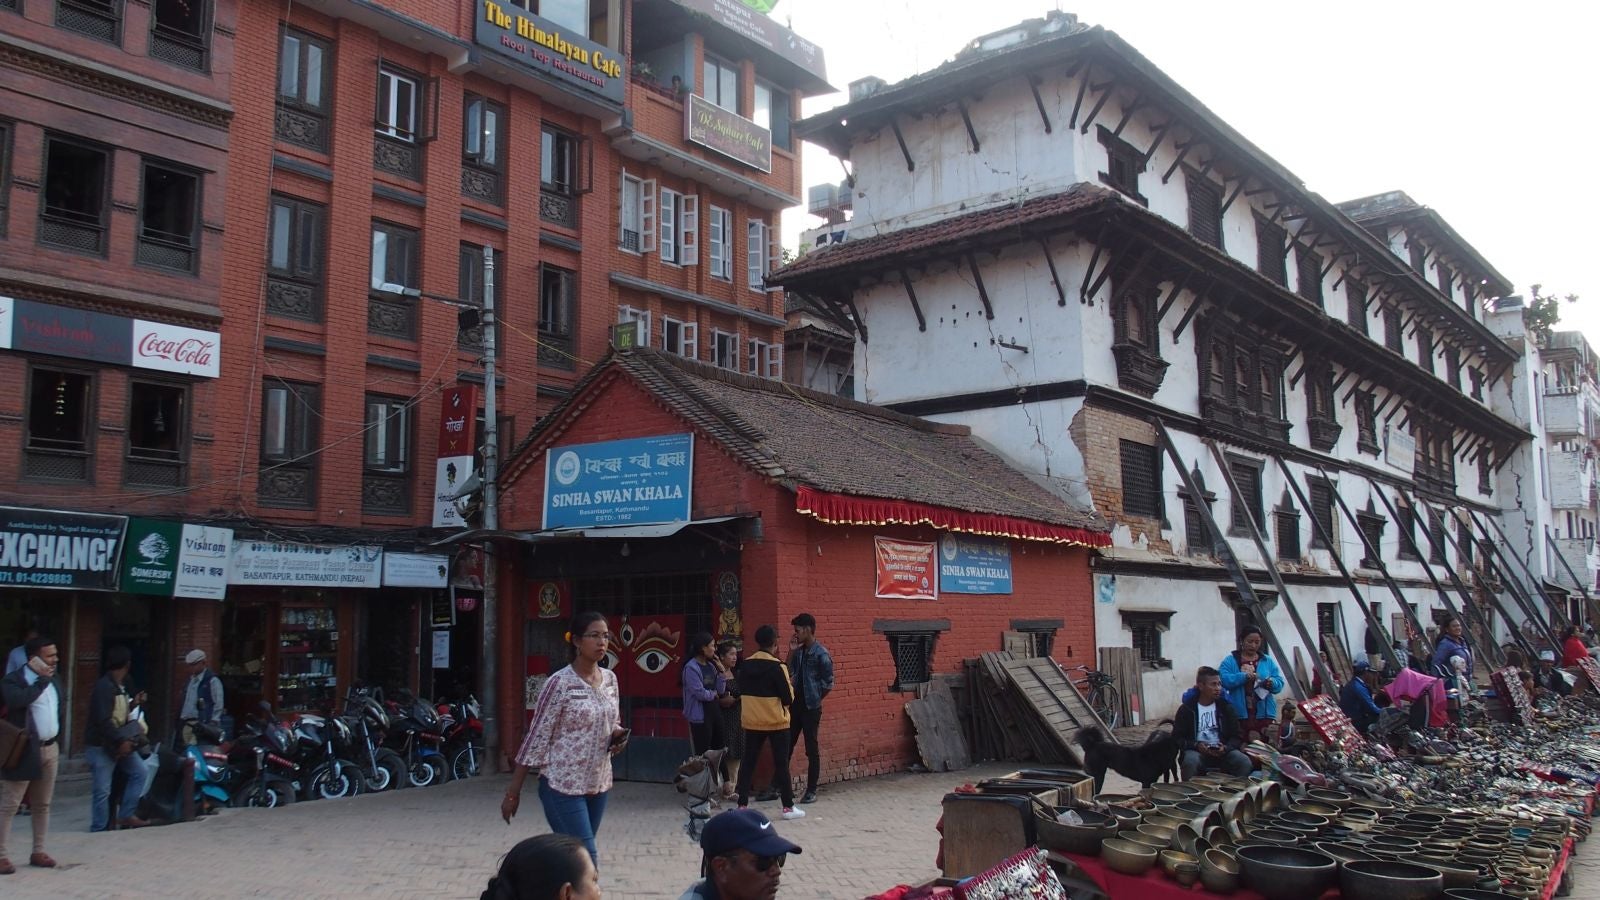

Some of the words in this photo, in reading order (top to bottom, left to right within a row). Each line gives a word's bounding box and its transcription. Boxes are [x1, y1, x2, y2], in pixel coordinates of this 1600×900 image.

[485, 1, 512, 29] The
[516, 15, 589, 63] Himalayan
[592, 50, 621, 78] Cafe
[501, 35, 527, 53] Roof
[531, 48, 550, 63] Top
[553, 59, 605, 88] Restaurant
[138, 332, 215, 366] Coca-Cola
[552, 492, 591, 508] SINHA
[594, 488, 632, 505] SWAN
[635, 484, 682, 500] KHALA
[48, 524, 57, 532] by
[131, 567, 172, 579] SOMERSBY
[243, 571, 292, 581] BASANTAPUR,
[295, 572, 339, 582] KATHMANDU
[340, 573, 366, 583] (NEPAL)
[943, 565, 965, 576] SINHA
[966, 567, 986, 577] SWAN
[987, 568, 1009, 579] KHALA
